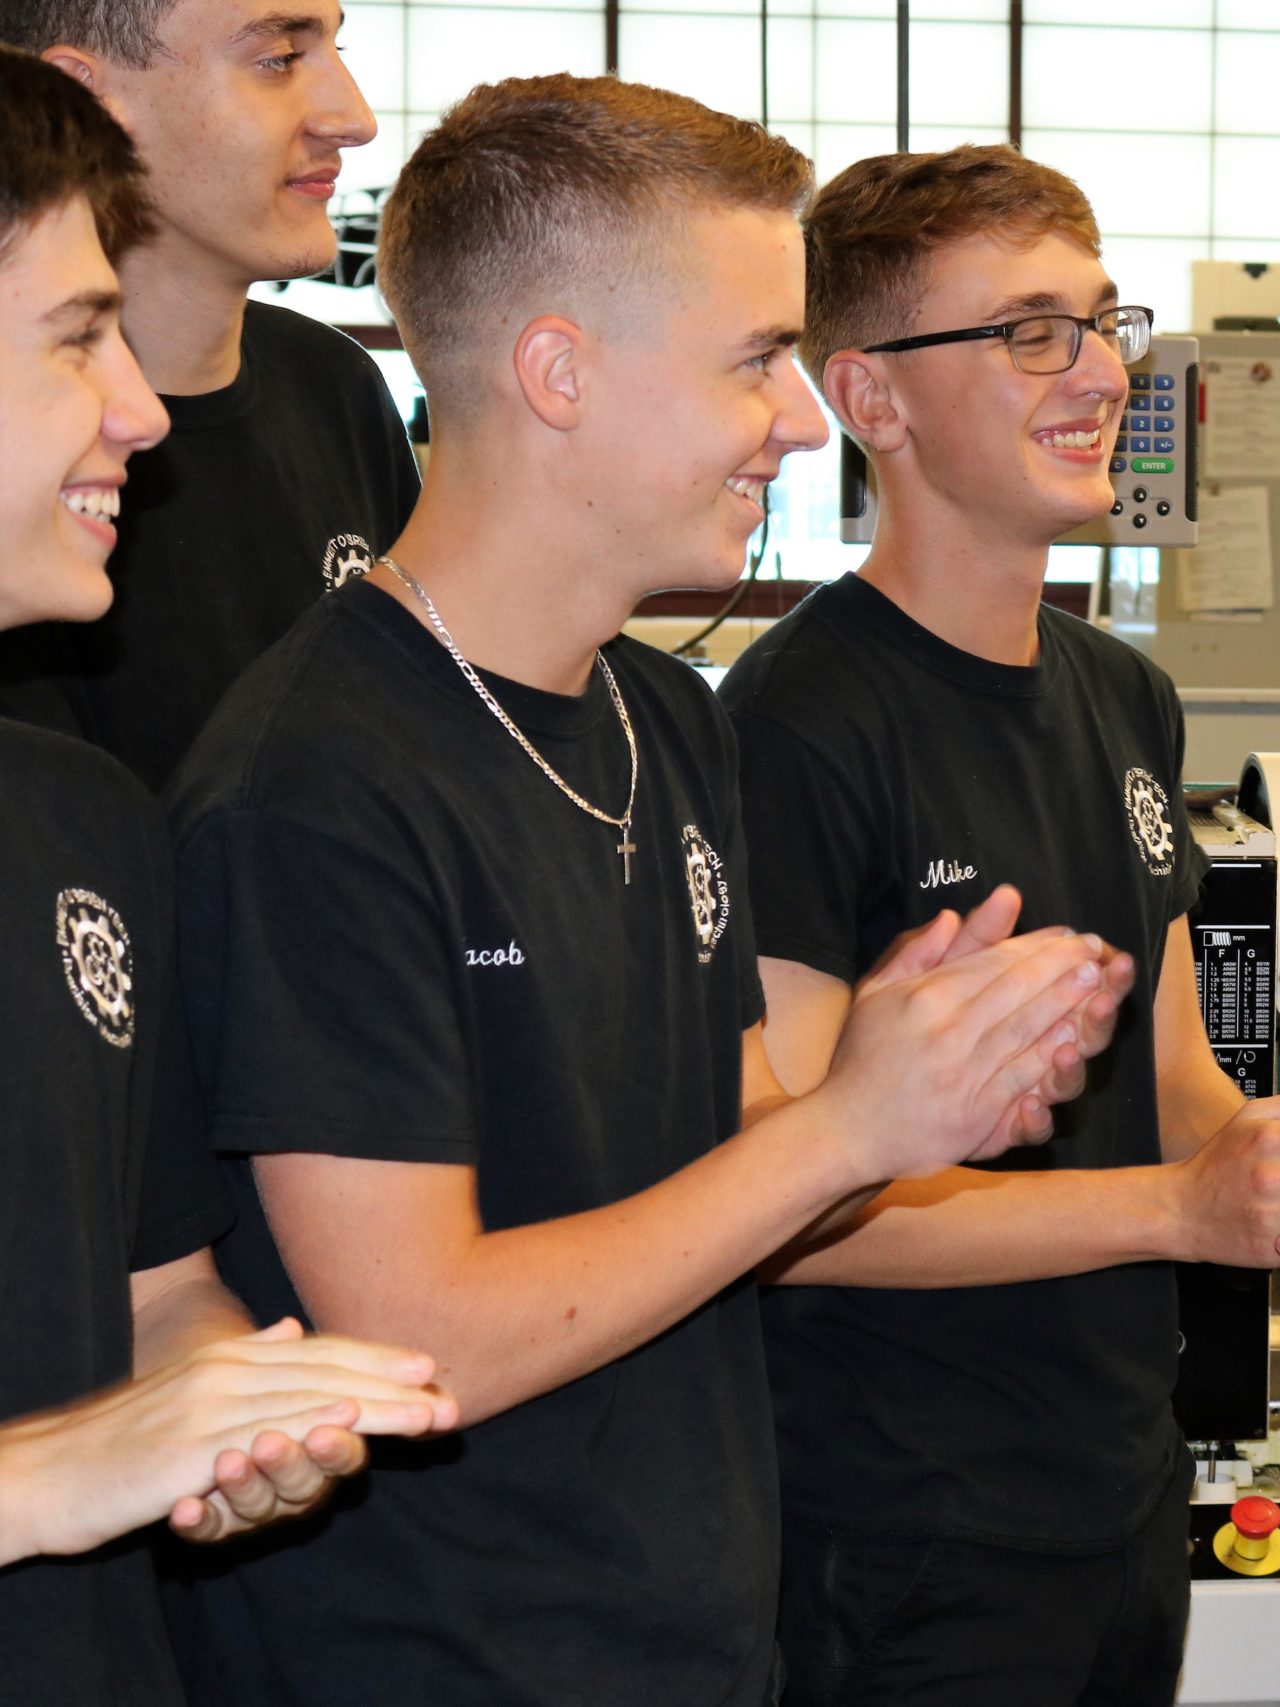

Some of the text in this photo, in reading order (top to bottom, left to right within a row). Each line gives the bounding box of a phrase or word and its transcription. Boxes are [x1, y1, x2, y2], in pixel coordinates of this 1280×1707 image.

[1164, 379, 1169, 387] 9
[1139, 420, 1144, 428] 2
[1142, 462, 1166, 470] ENTER
[920, 859, 977, 888] Mike
[465, 939, 525, 966] acob
[1218, 949, 1256, 958] F G
[1237, 1067, 1246, 1076] G
